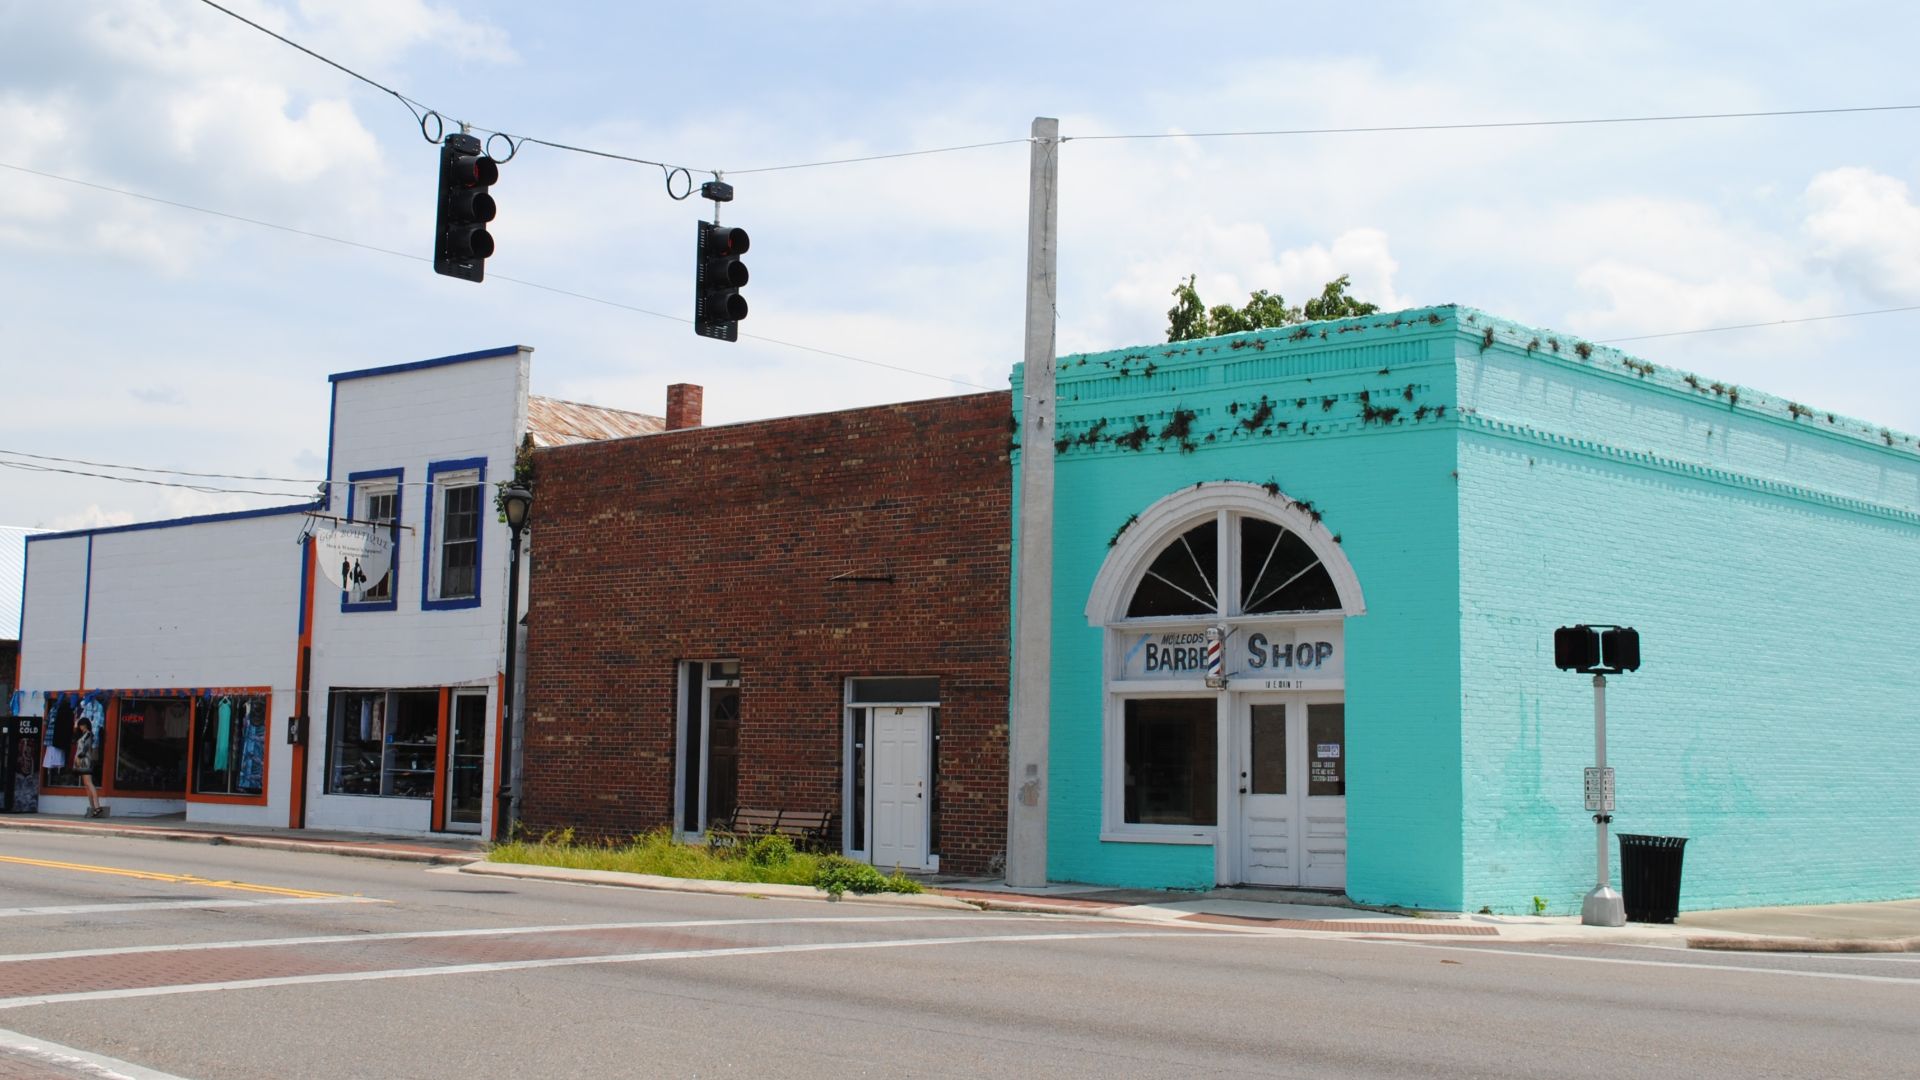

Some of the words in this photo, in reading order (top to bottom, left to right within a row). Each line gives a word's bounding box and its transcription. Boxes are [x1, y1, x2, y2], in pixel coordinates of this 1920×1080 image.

[1145, 642, 1208, 671] BARBE
[1296, 680, 1304, 689] ST
[19, 726, 39, 734] COLD
